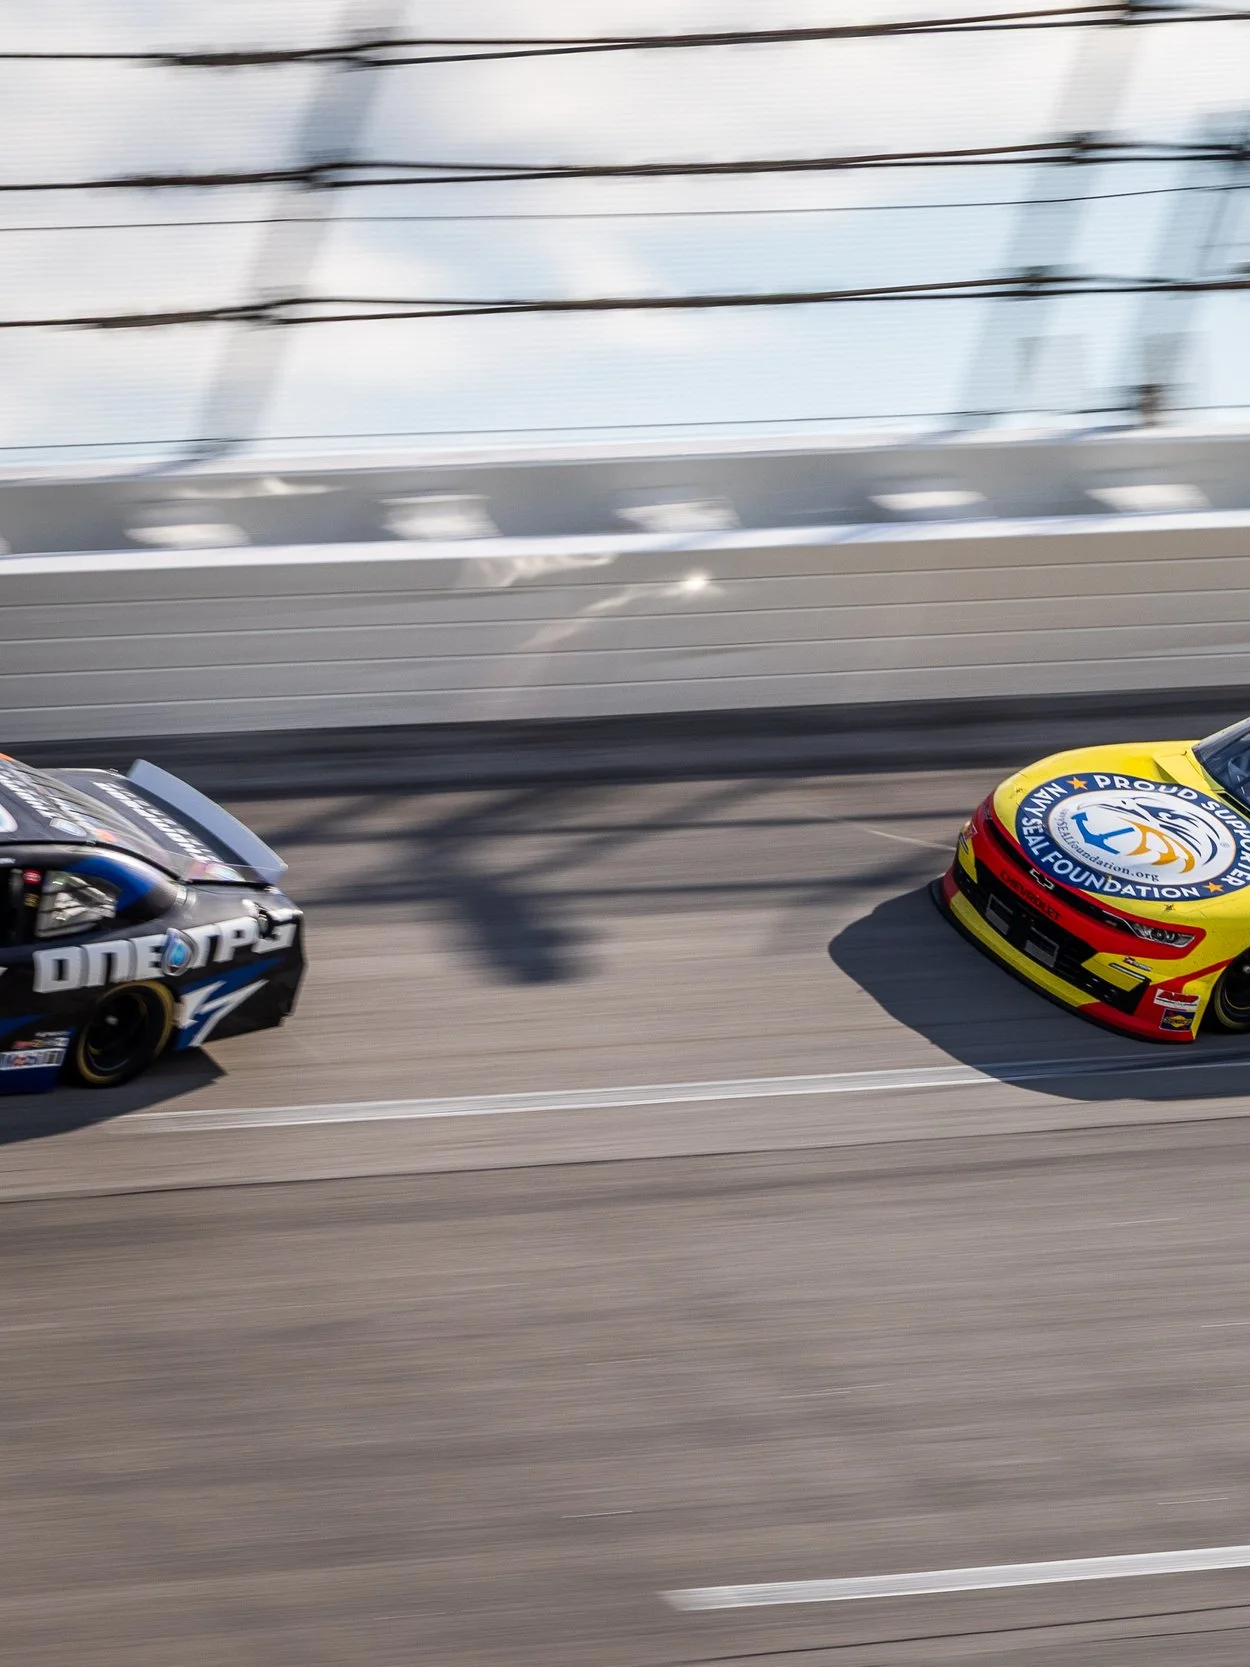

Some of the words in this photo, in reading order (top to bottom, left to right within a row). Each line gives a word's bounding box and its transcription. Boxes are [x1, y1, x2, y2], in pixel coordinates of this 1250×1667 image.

[1024, 782, 1068, 820] NAVY
[1093, 775, 1198, 801] PROUD
[1022, 816, 1044, 855] SEAL
[1041, 851, 1200, 899] FOUNDATION
[1000, 870, 1062, 921] CHEVROLET
